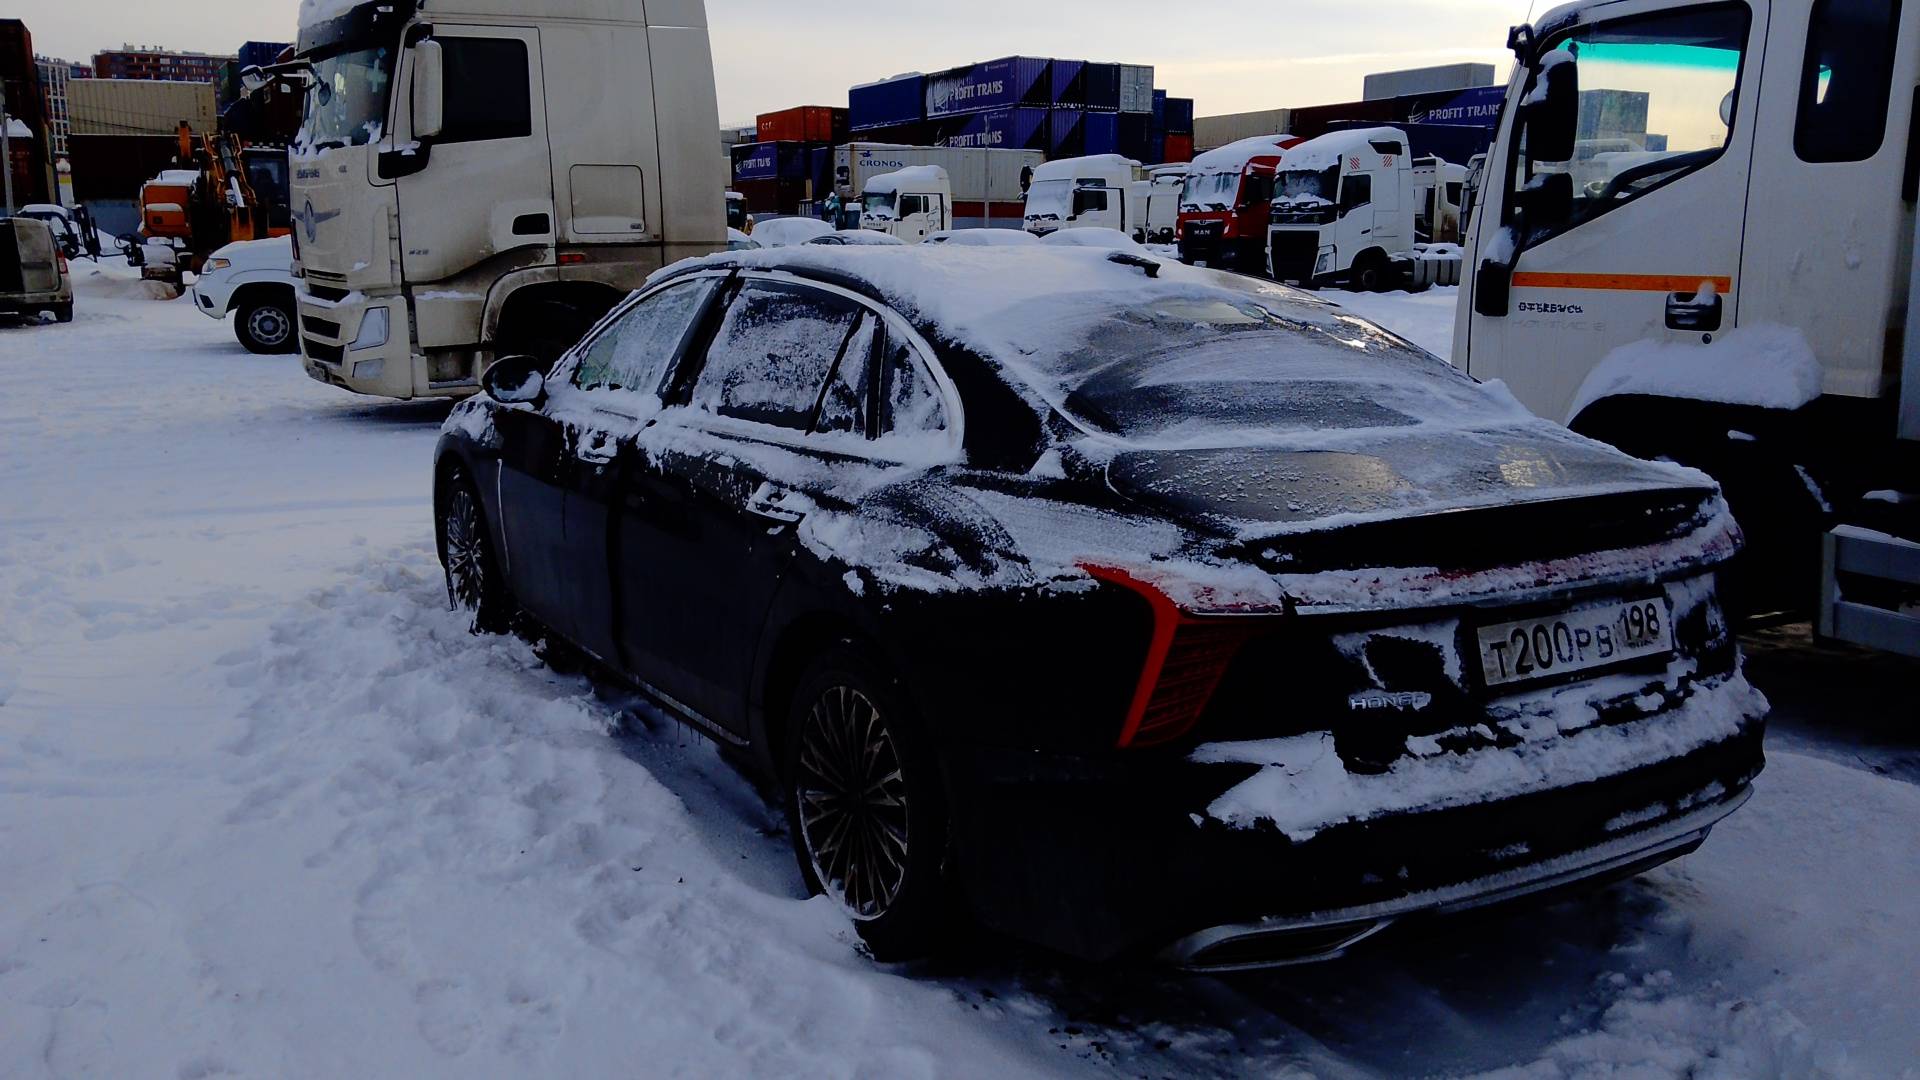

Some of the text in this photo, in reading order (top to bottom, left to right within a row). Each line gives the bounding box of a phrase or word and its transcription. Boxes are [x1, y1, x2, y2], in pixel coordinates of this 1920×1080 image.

[949, 79, 1003, 101] PROFIT TRANS
[1428, 106, 1465, 120] PROFIT
[948, 133, 975, 147] PROFIT
[859, 159, 904, 168] CRONOS
[1617, 603, 1660, 641] 198
